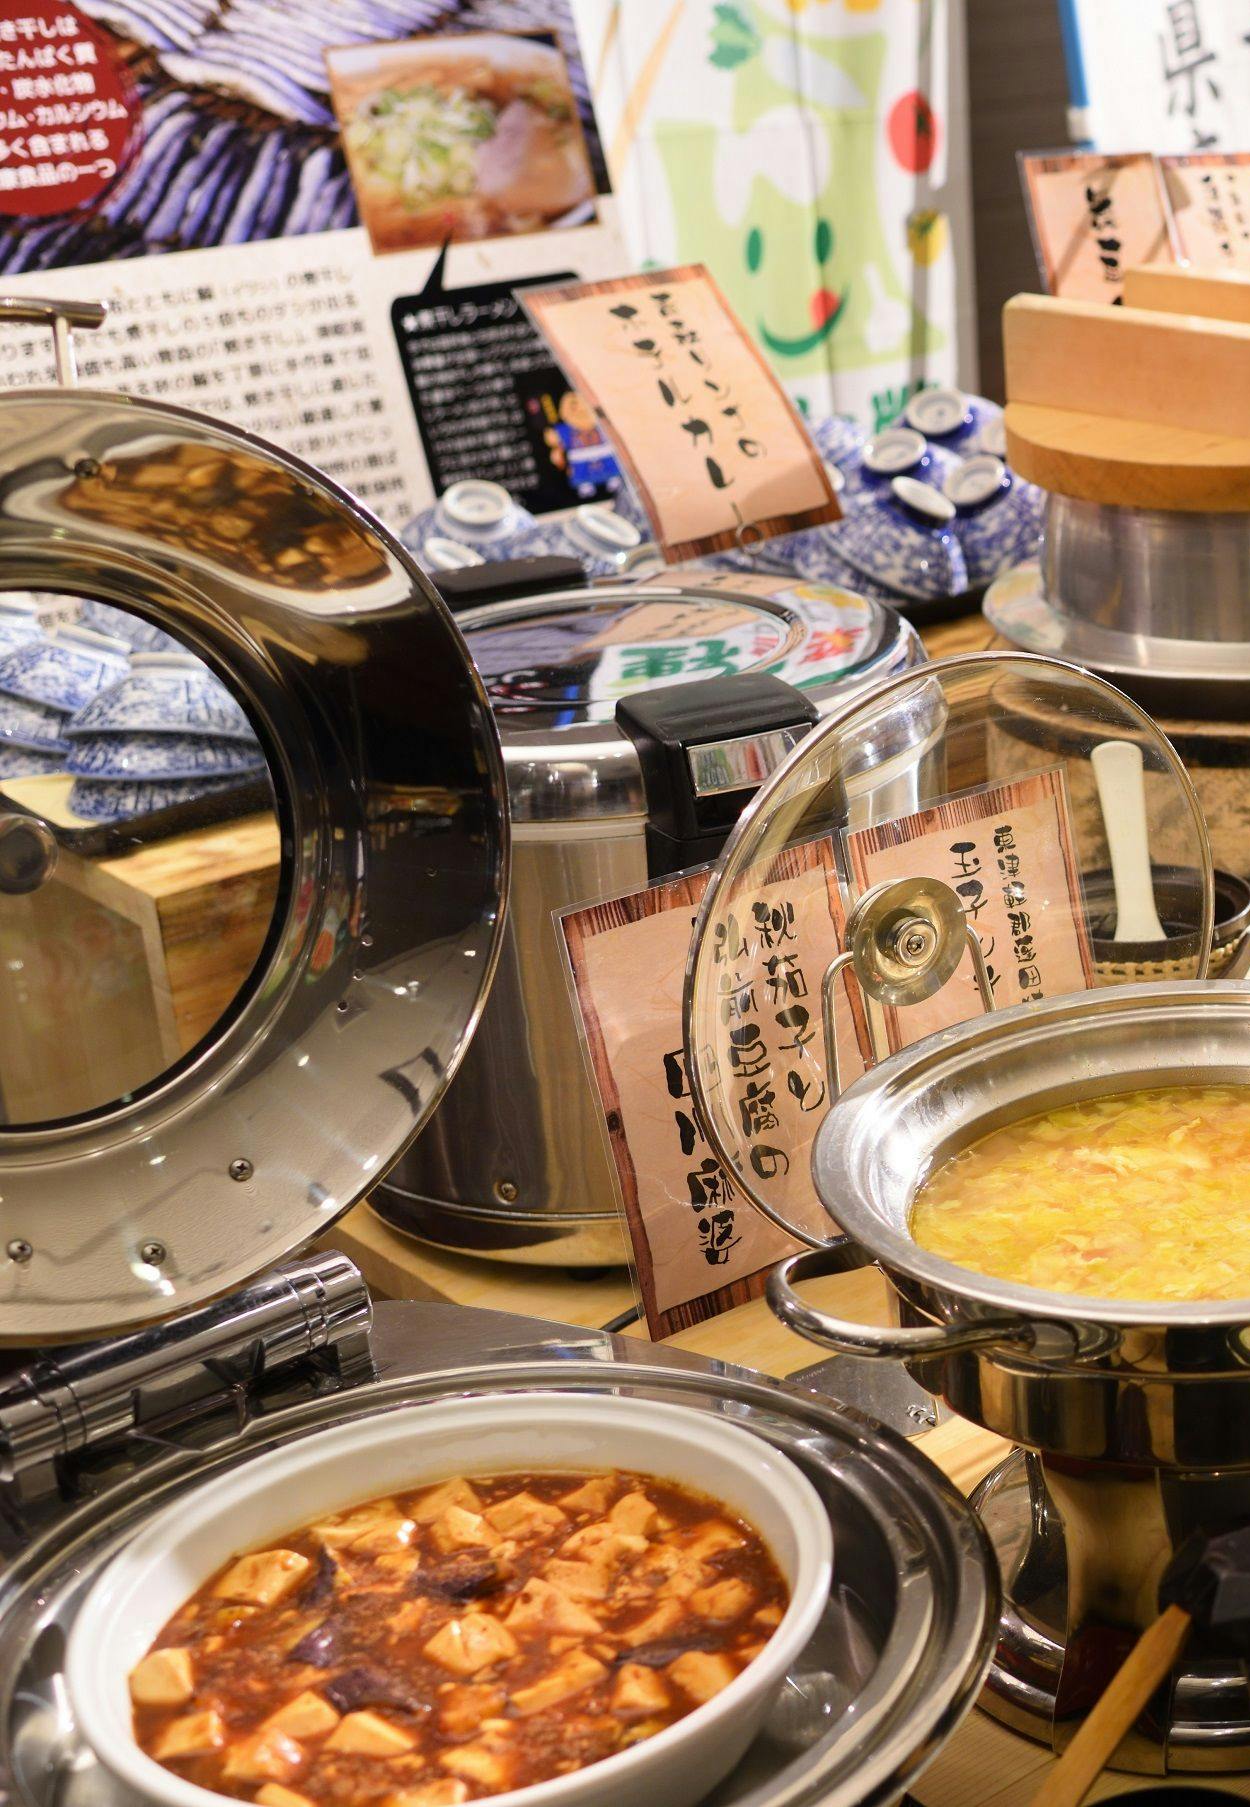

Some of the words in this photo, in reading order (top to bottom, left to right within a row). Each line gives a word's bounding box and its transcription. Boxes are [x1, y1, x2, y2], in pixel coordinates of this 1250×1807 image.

[714, 912, 790, 1180] 弘前豆腐の
[751, 900, 826, 1113] 秋茄子と
